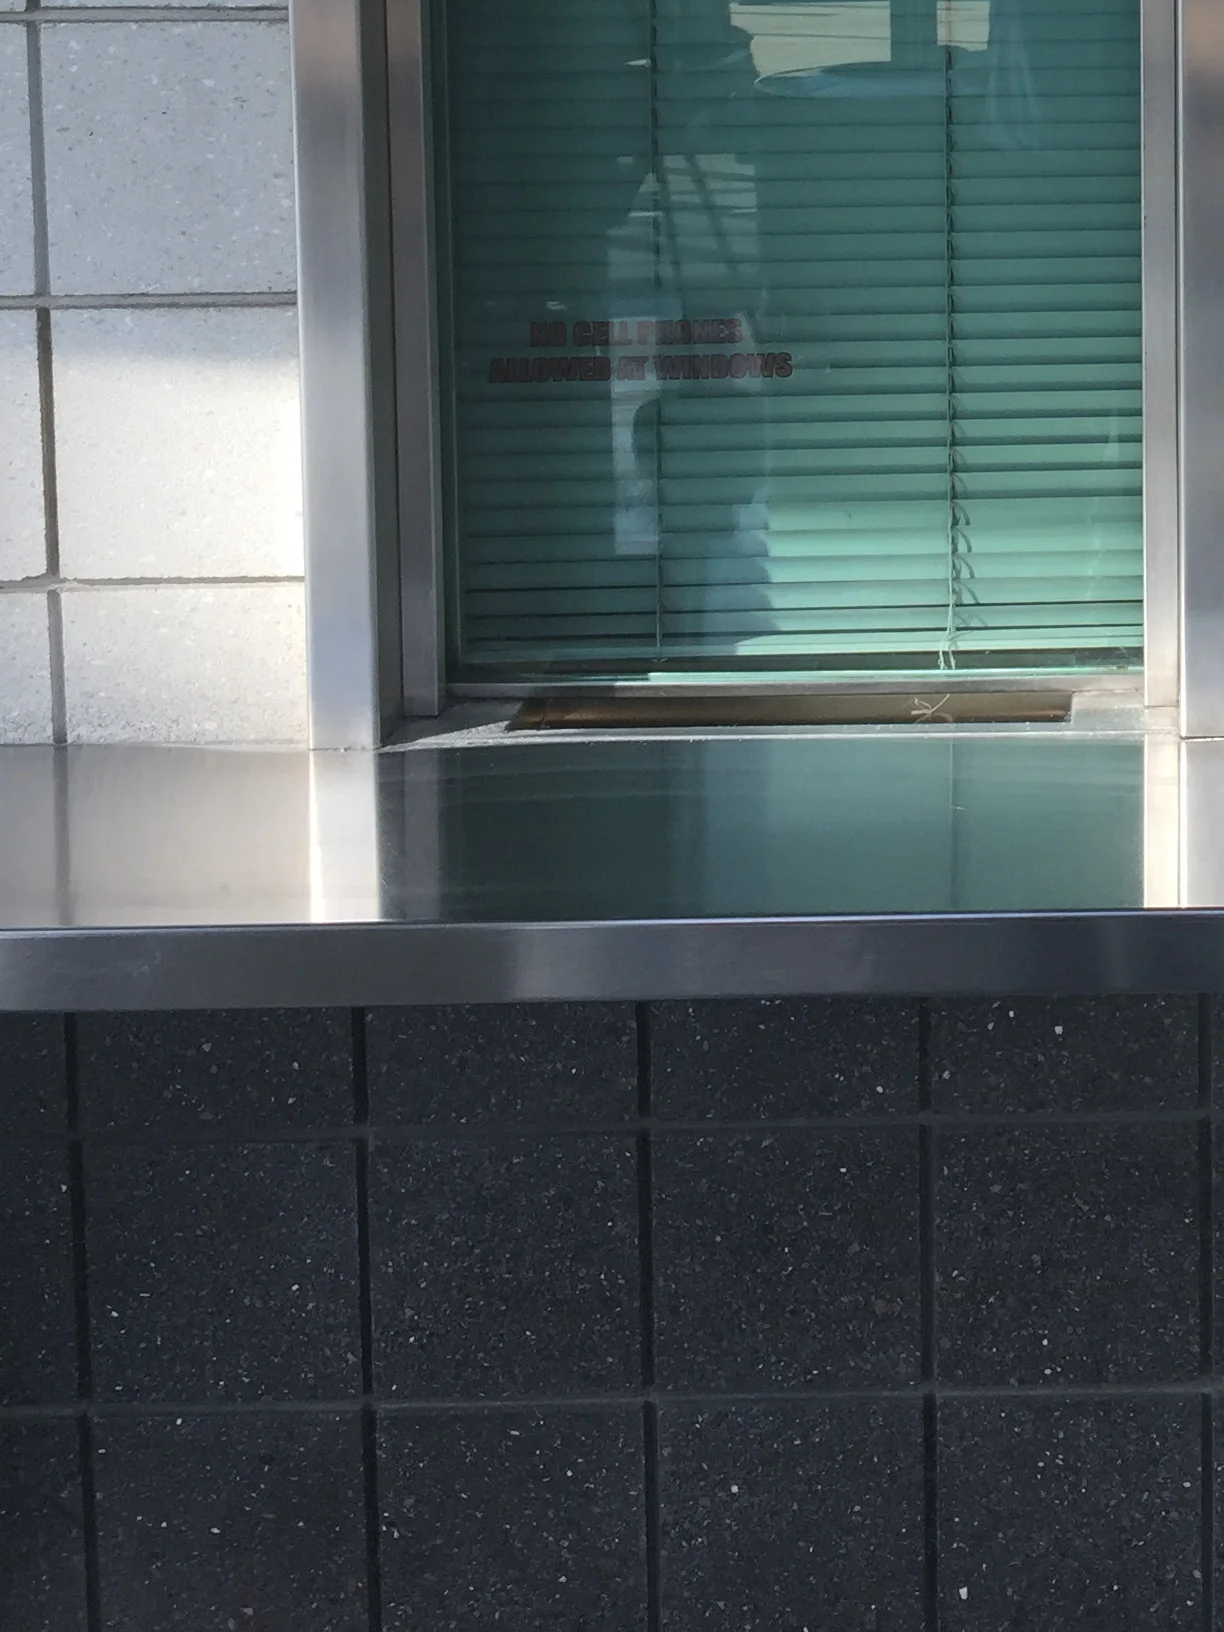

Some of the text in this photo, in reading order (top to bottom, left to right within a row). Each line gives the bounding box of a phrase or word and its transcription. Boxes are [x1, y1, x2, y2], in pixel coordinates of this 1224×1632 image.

[530, 319, 742, 347] NO CELL PHONES
[488, 352, 793, 383] ALLOWED AT WINDOWS
